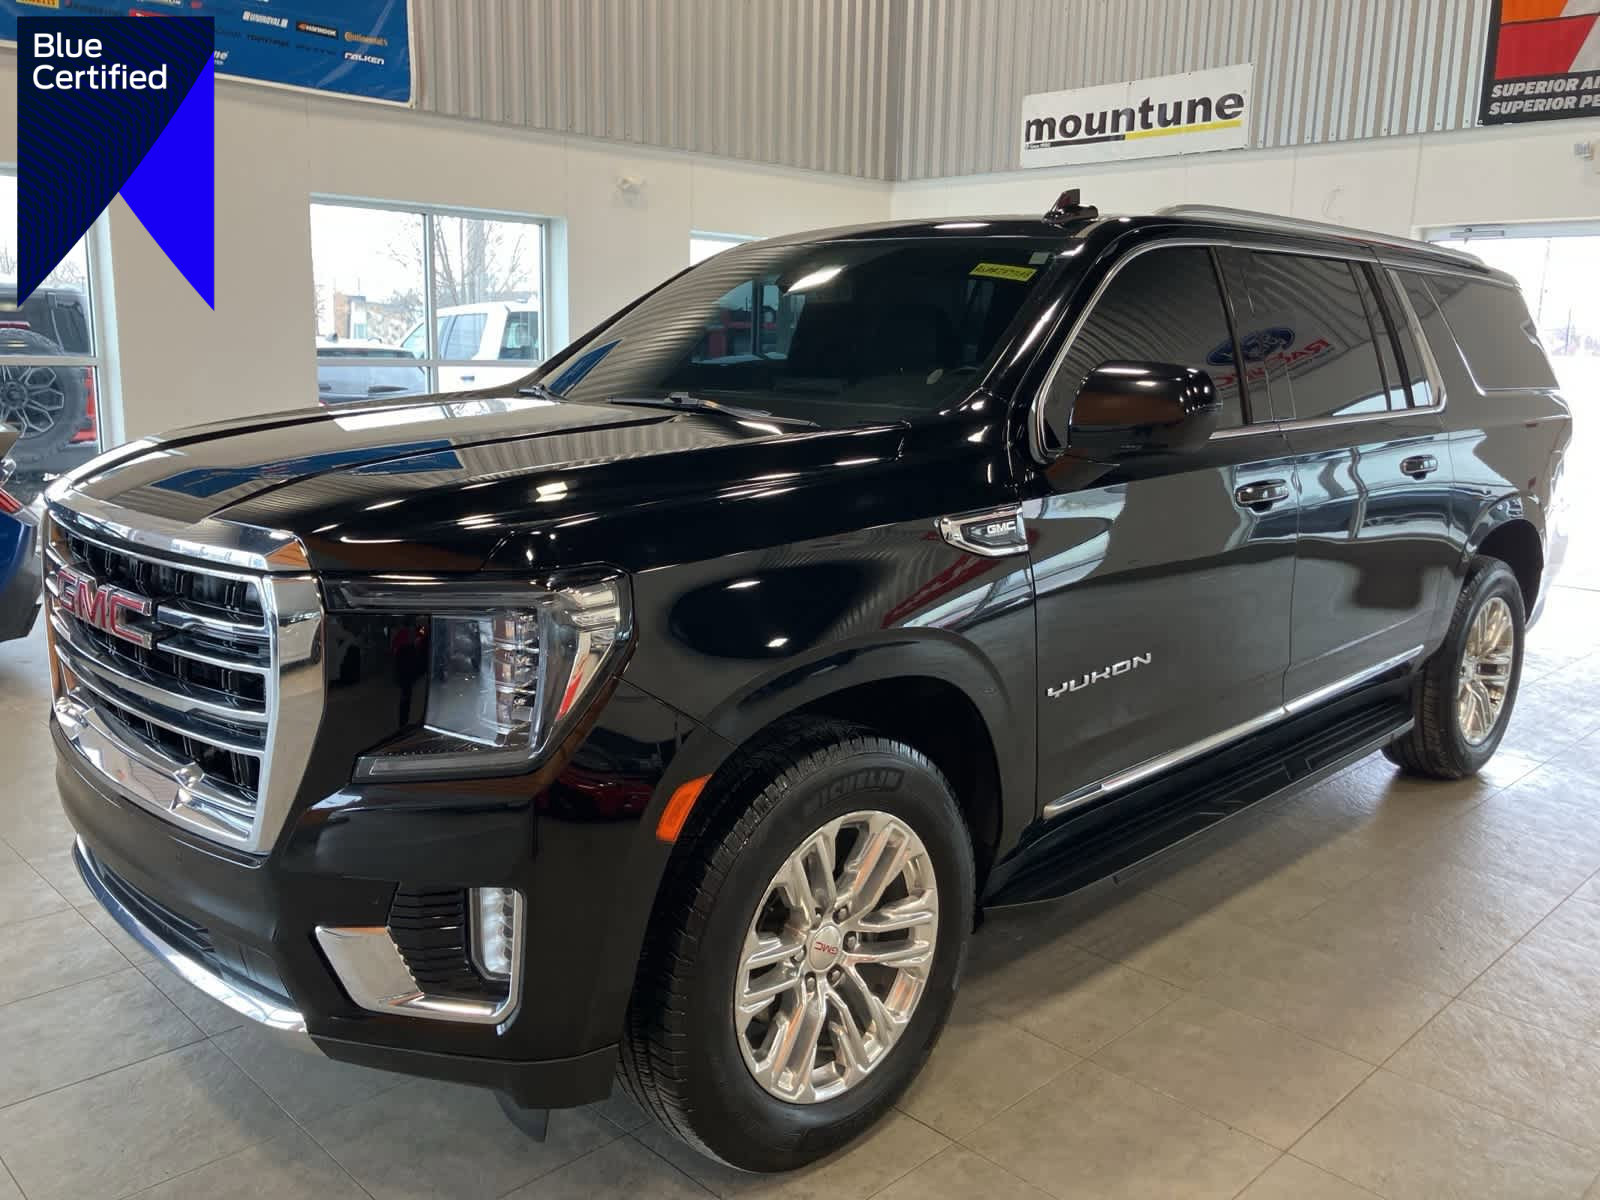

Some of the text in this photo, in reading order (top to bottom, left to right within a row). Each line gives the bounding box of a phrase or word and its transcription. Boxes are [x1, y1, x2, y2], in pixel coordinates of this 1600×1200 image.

[344, 52, 385, 65] FALKEN
[1491, 78, 1579, 98] SUPERIOR
[1488, 95, 1578, 116] SUPERIOR
[1025, 92, 1245, 143] mountune
[986, 521, 1016, 534] GMC
[56, 565, 152, 650] GMC
[1047, 652, 1151, 699] YUKON
[815, 941, 839, 956] GMC
